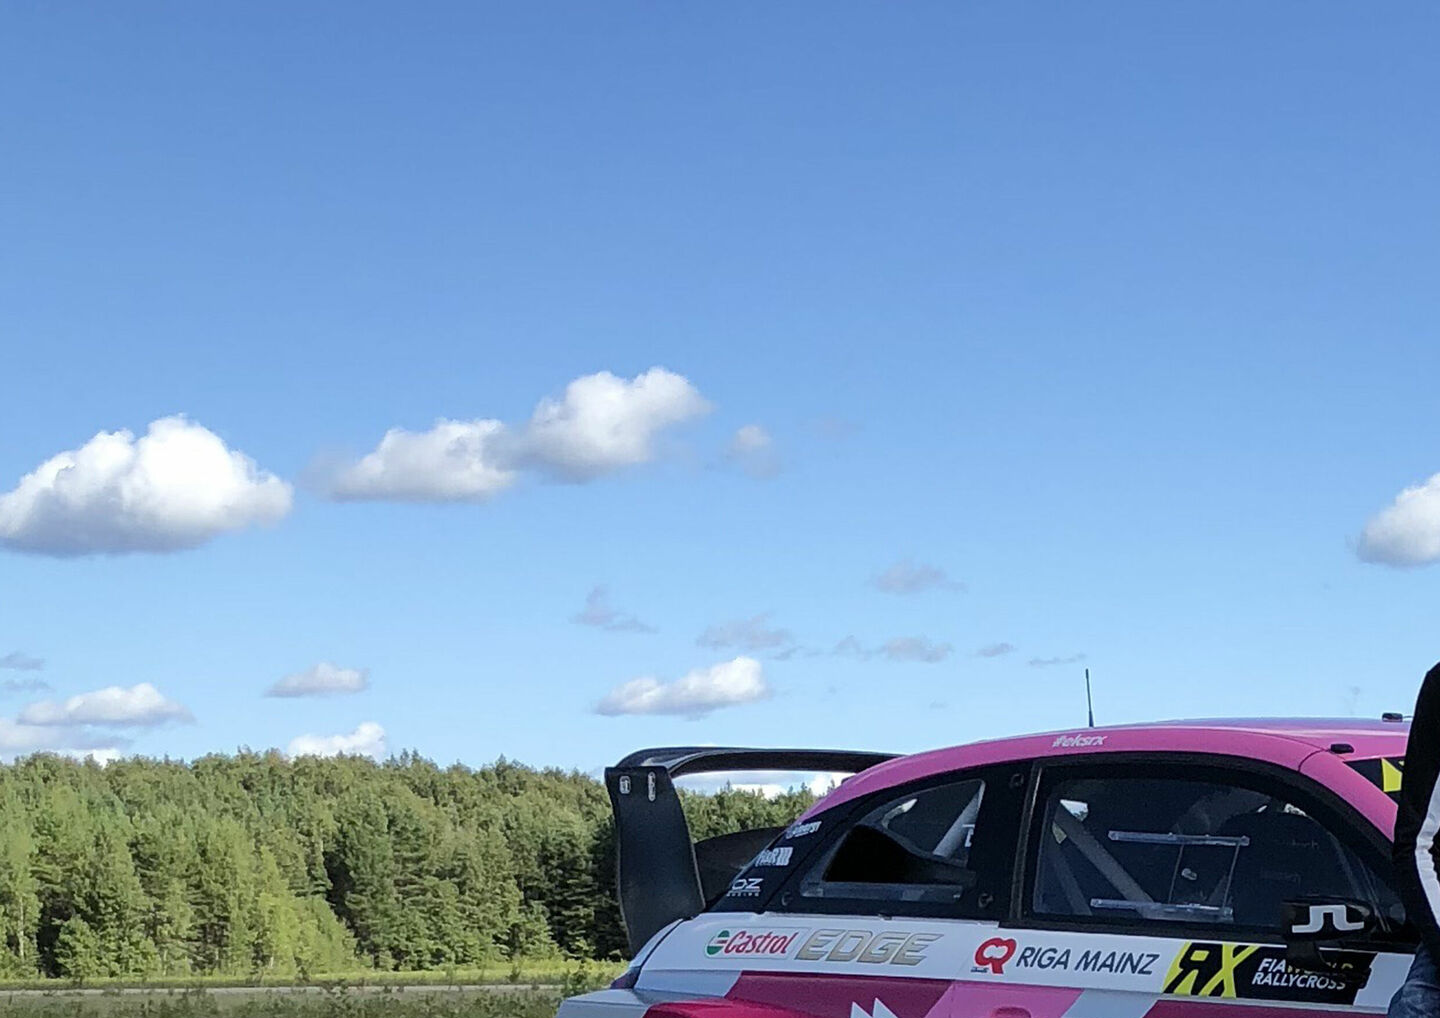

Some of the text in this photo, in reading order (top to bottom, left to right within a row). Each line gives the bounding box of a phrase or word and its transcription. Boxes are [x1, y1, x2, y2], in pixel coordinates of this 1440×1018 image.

[724, 928, 944, 966] Castrol EDGE
[1016, 946, 1160, 975] RIGA MAINZ
[1258, 958, 1287, 973] FIA
